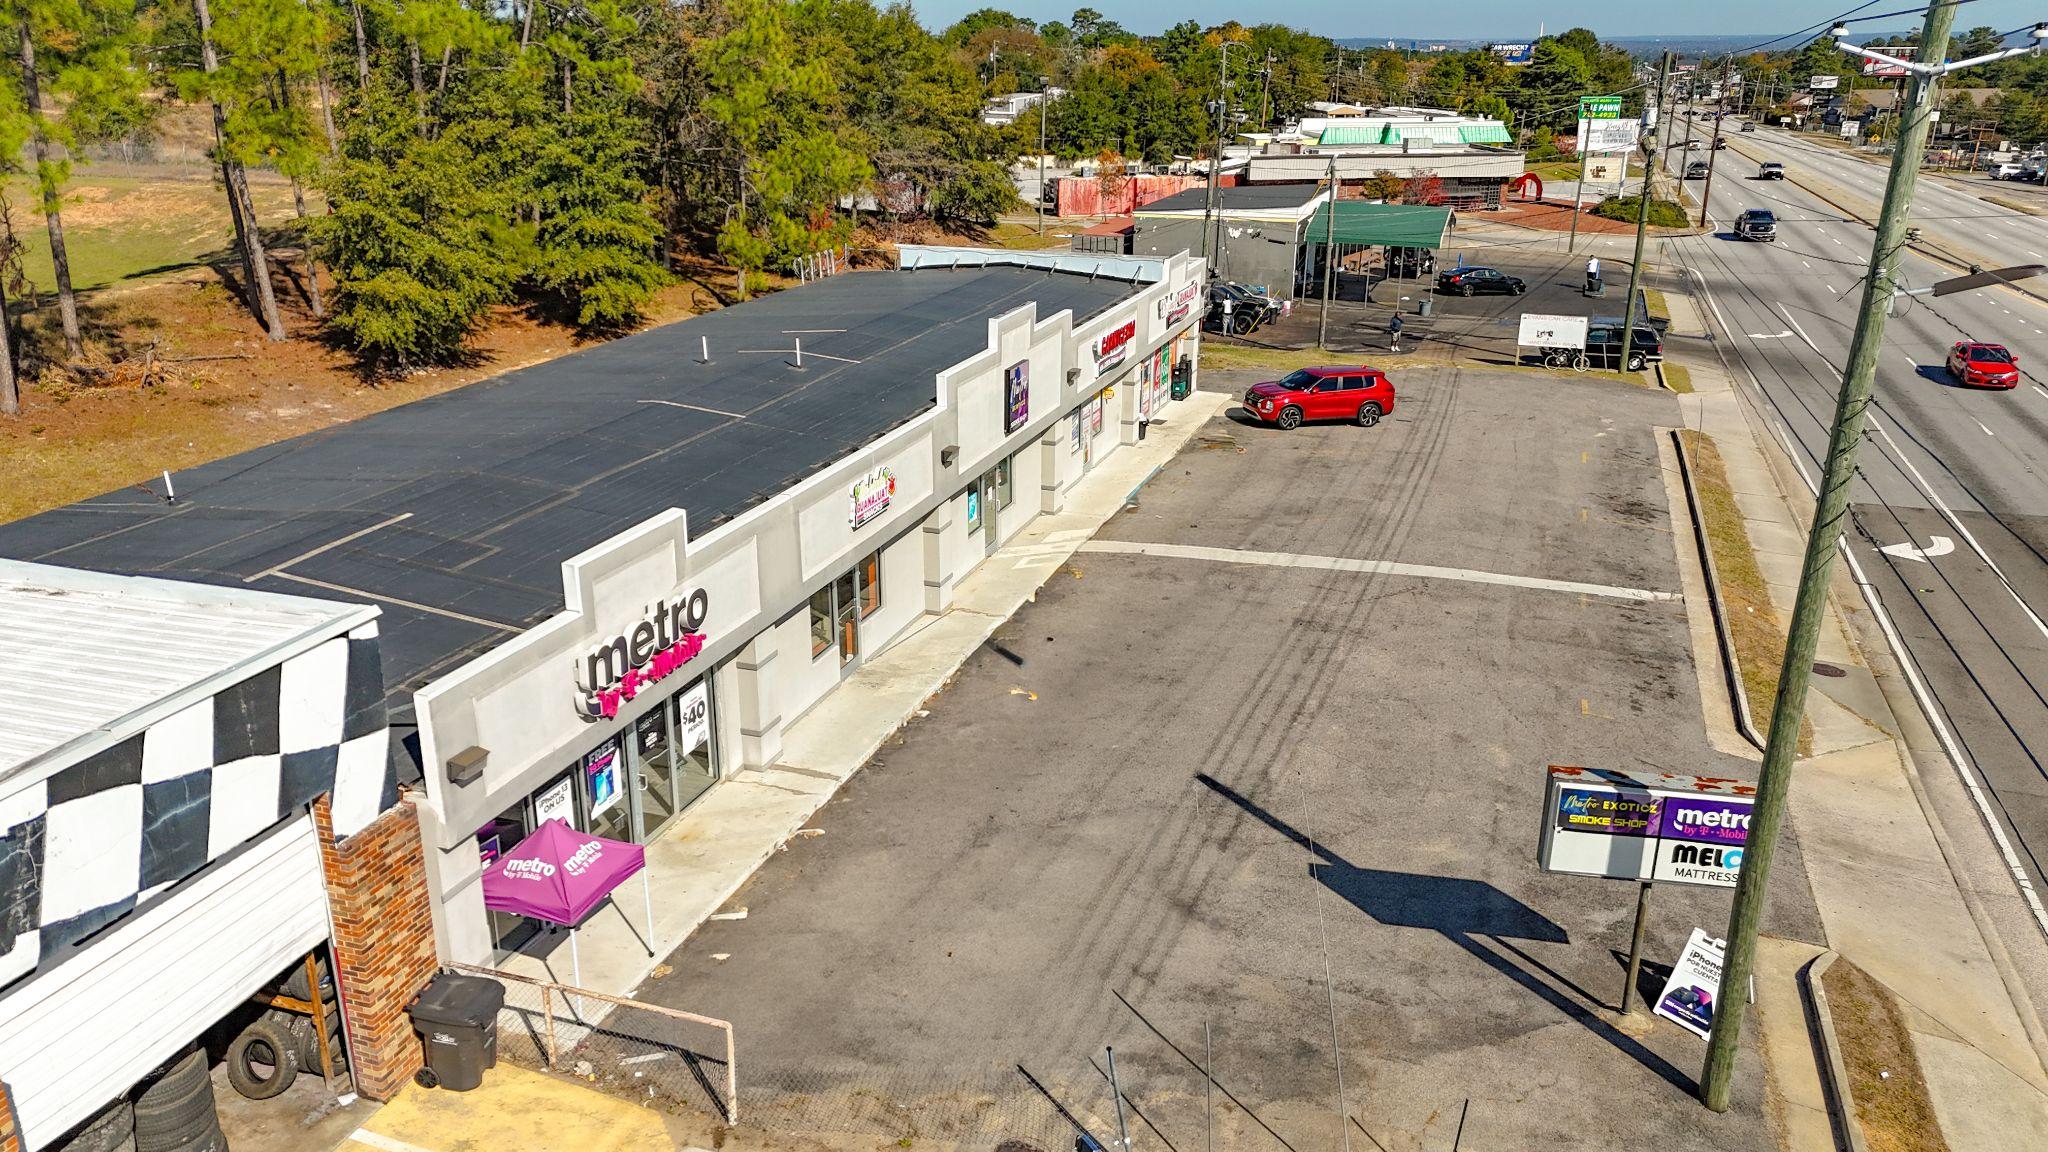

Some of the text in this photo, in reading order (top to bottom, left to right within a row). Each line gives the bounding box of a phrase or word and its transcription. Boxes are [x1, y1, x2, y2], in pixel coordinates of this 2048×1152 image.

[583, 587, 708, 691] metro
[682, 700, 706, 726] $40
[588, 738, 616, 766] FREE
[538, 790, 561, 808] iPhone
[544, 794, 565, 813] ON US
[1564, 794, 1658, 814] Metro EXOTICZ
[1568, 814, 1648, 828] SMOKE SHOP
[1684, 825, 1697, 836] by
[564, 840, 602, 872] metro
[506, 857, 556, 876] metro
[1674, 867, 1738, 882] MATTRESS
[1686, 957, 1700, 968] POR
[1690, 950, 1722, 971] iPhone
[1692, 968, 1719, 983] CUENTA
